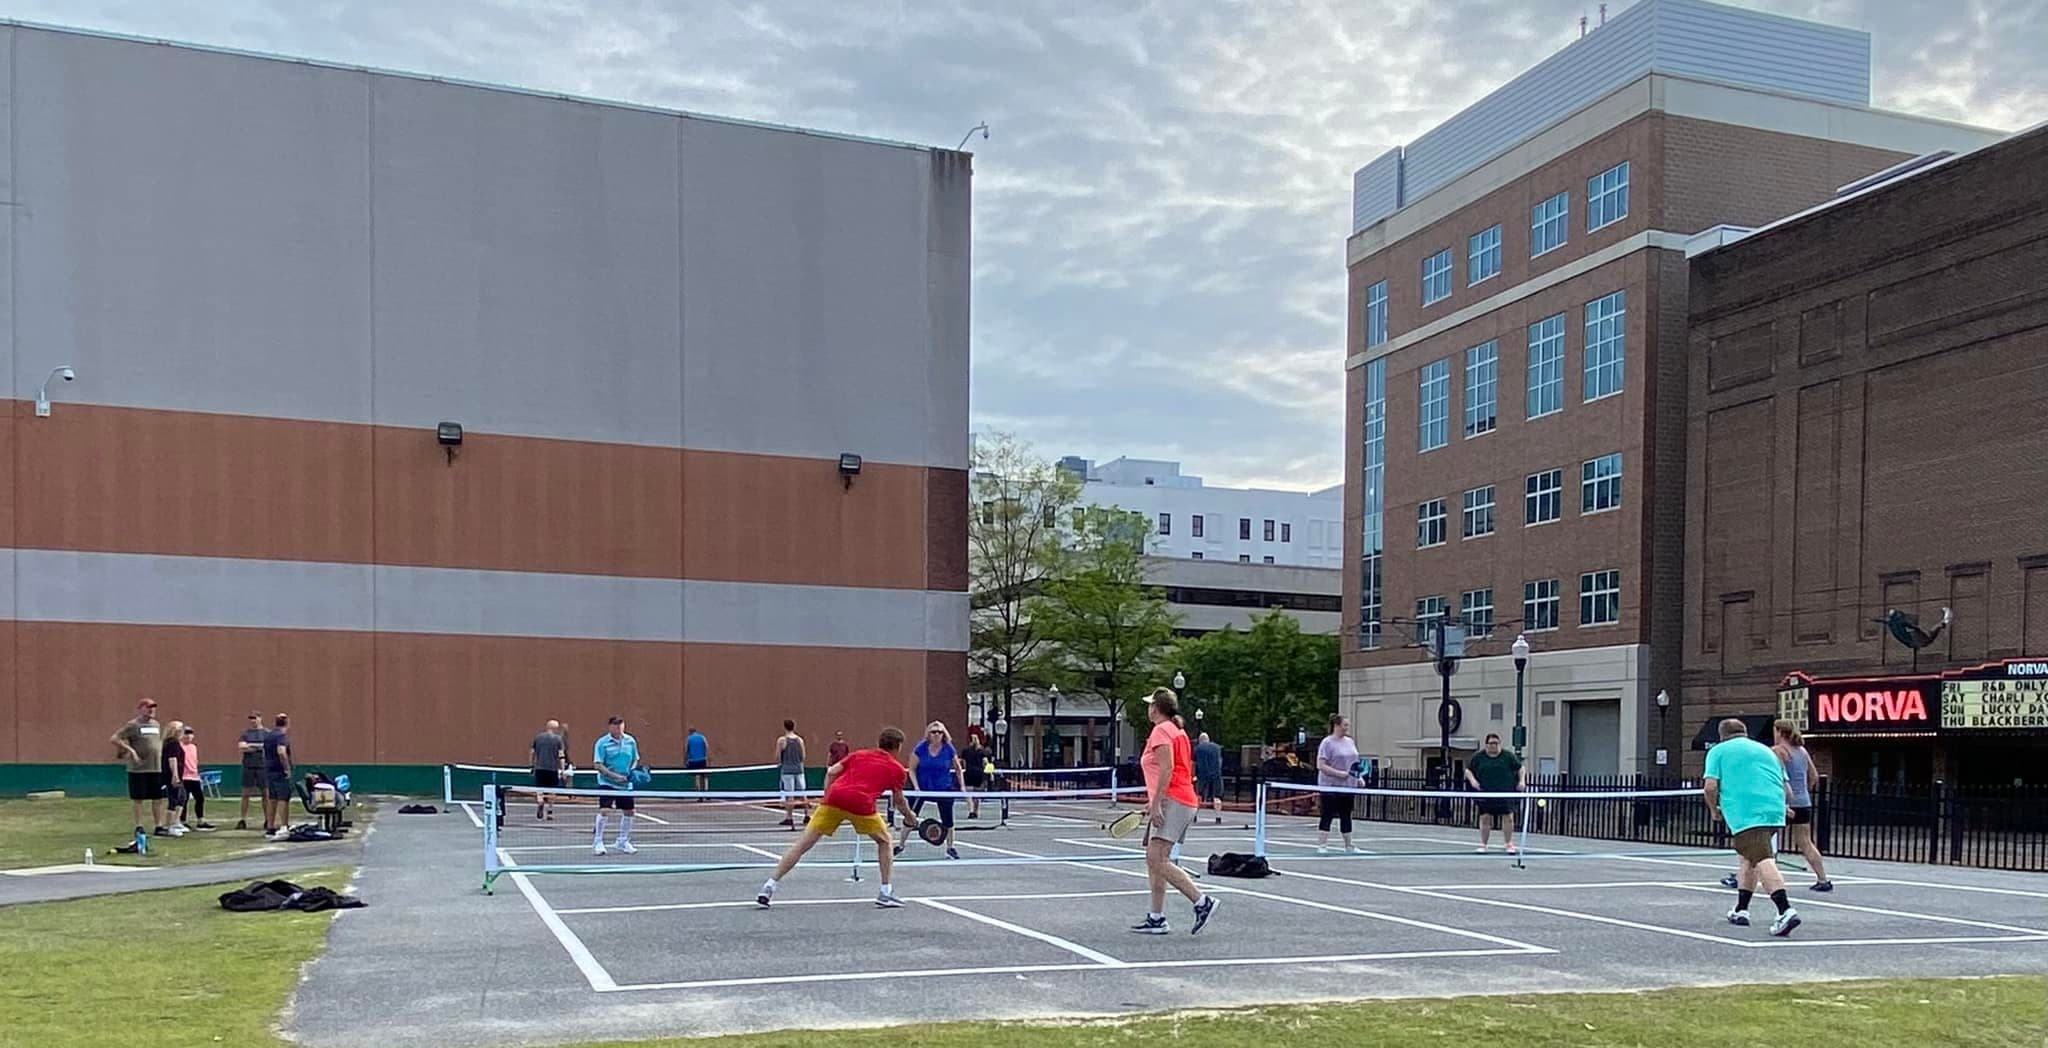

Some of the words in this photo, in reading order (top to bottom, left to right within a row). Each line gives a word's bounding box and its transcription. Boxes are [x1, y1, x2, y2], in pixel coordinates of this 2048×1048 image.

[2008, 663, 2048, 676] NORVA
[1943, 682, 1961, 693] FRI
[2015, 681, 2047, 691] ONLY
[1943, 693, 1965, 704] SAT
[1982, 693, 2024, 704] CHARLI
[1818, 690, 1927, 722] NORVA
[1943, 704, 1965, 715] SUN
[1982, 704, 2021, 715] LUCKY
[1943, 716, 1965, 726] THU
